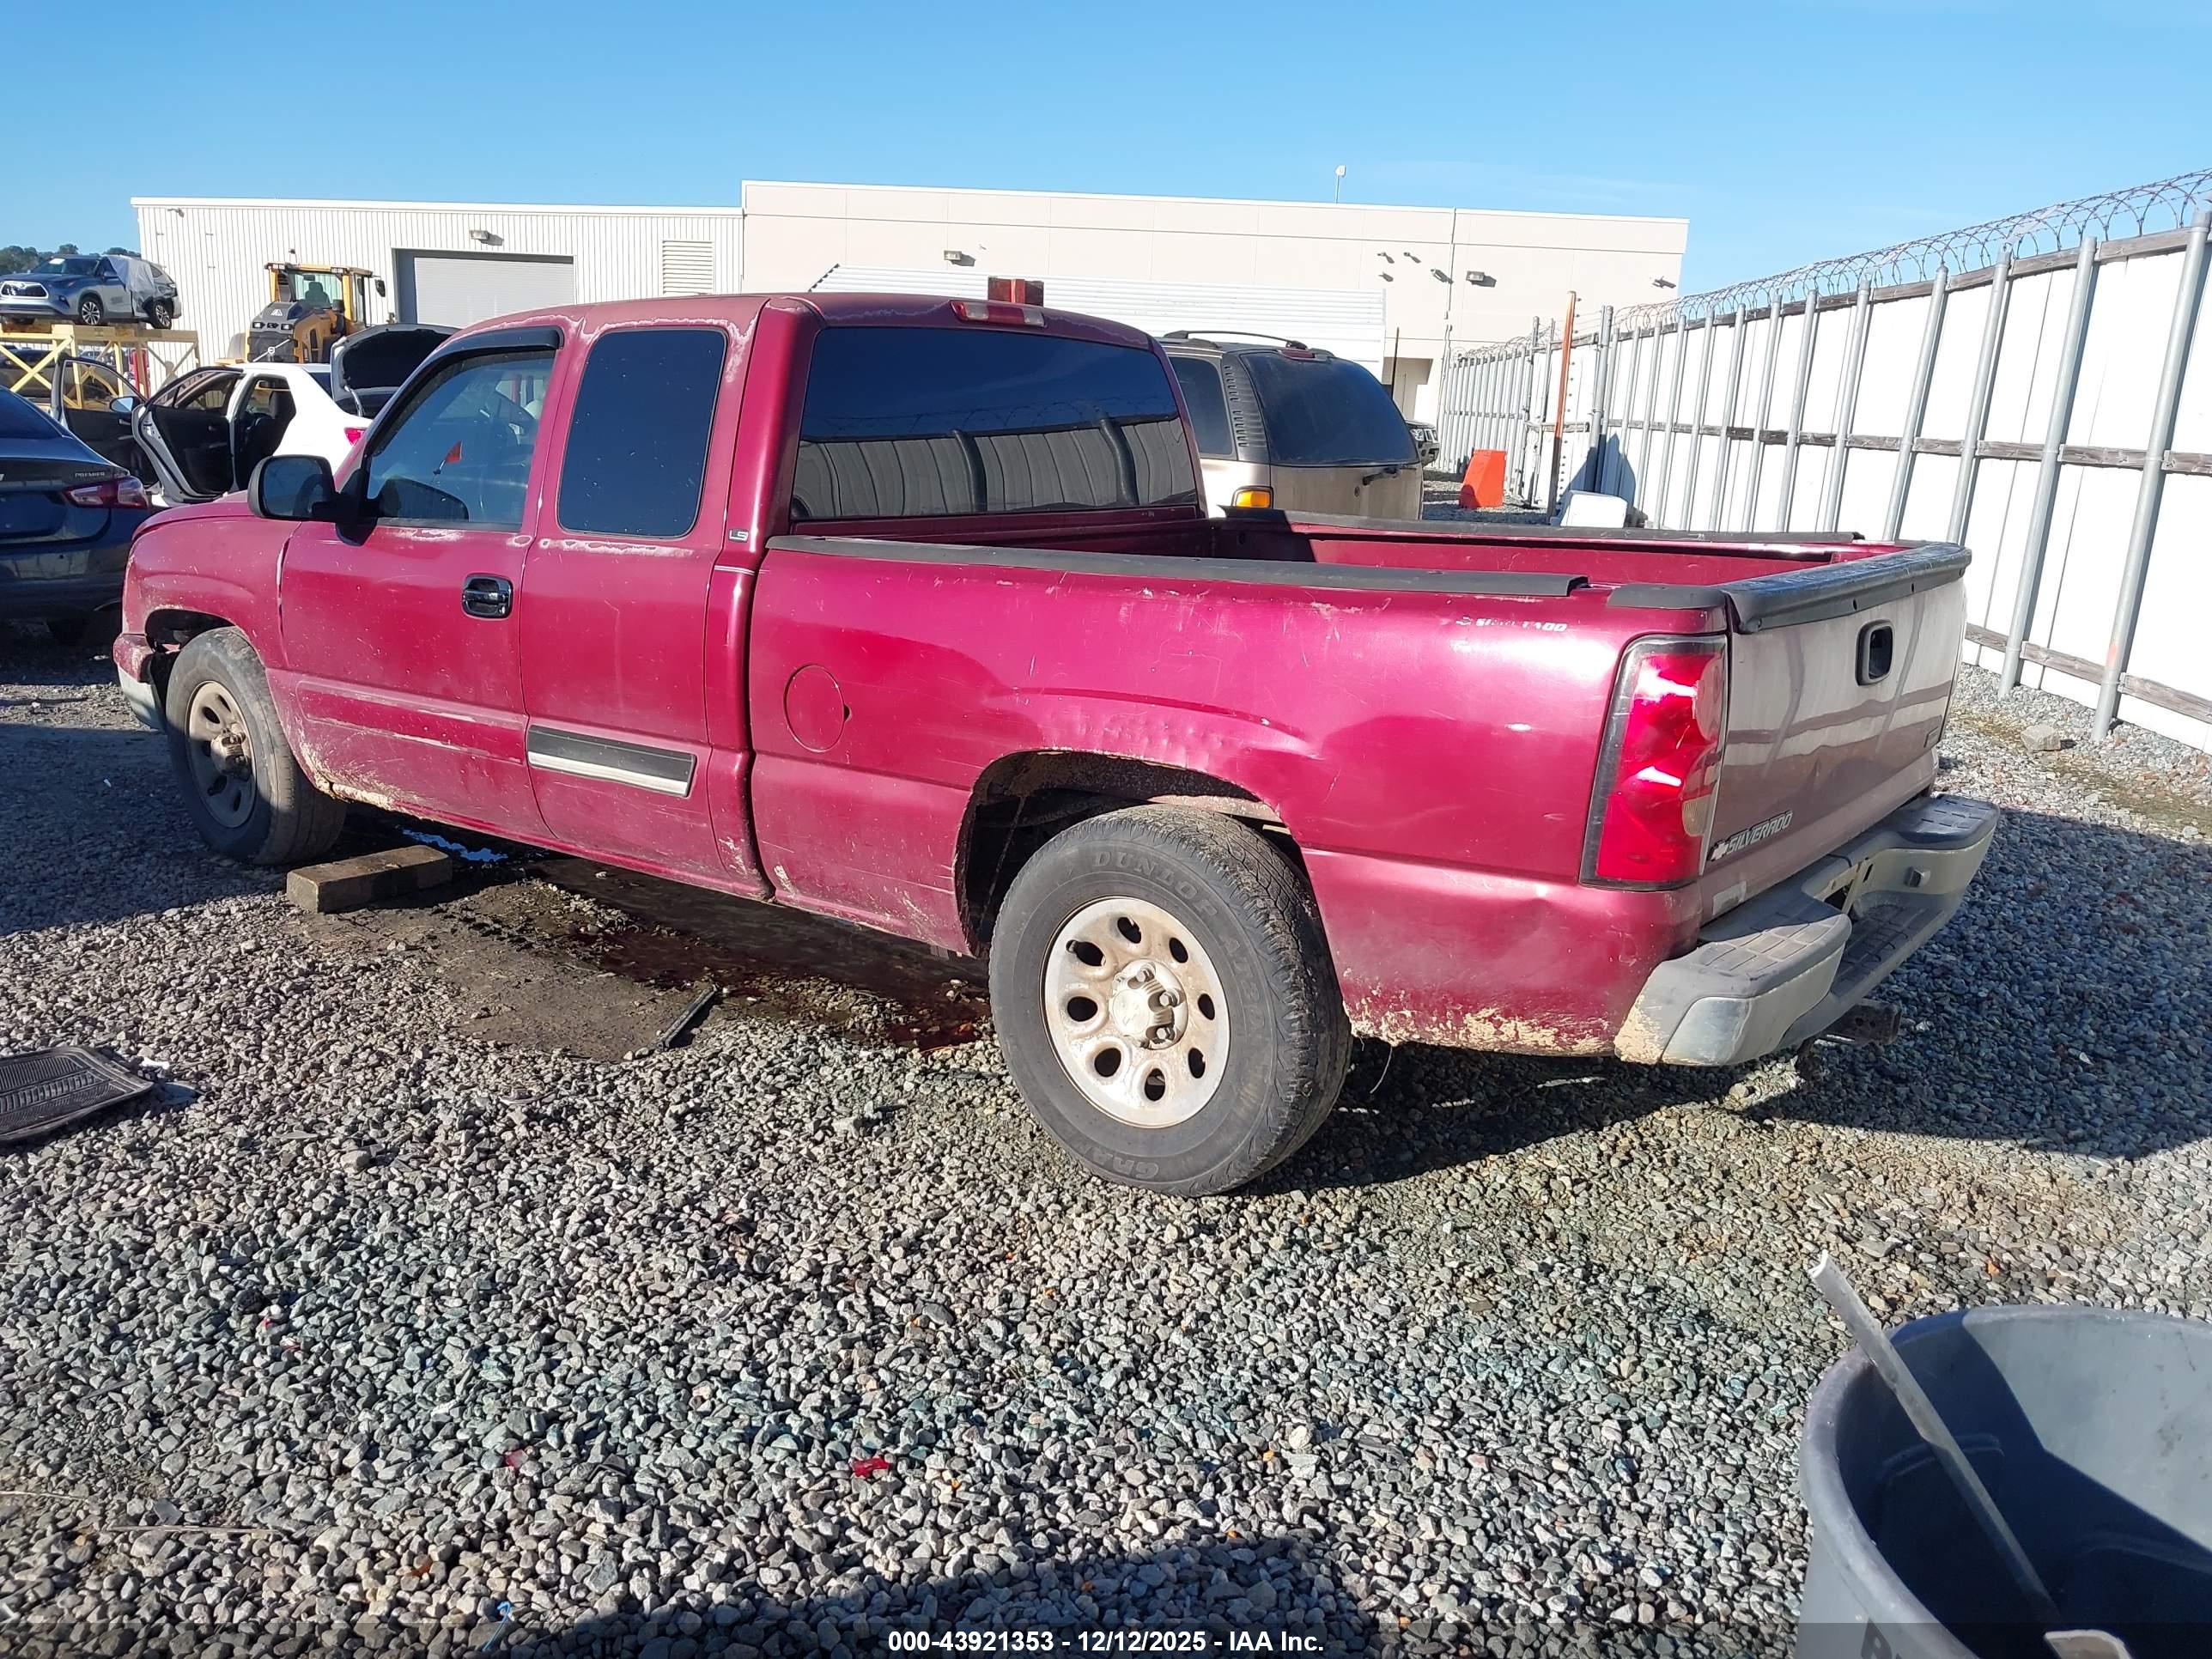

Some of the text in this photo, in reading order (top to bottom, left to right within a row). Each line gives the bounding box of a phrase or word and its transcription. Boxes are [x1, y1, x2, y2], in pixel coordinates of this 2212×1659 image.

[729, 529, 749, 542] LS
[1726, 811, 1793, 855] SILVERADO
[1091, 850, 1218, 915] DUNLOP
